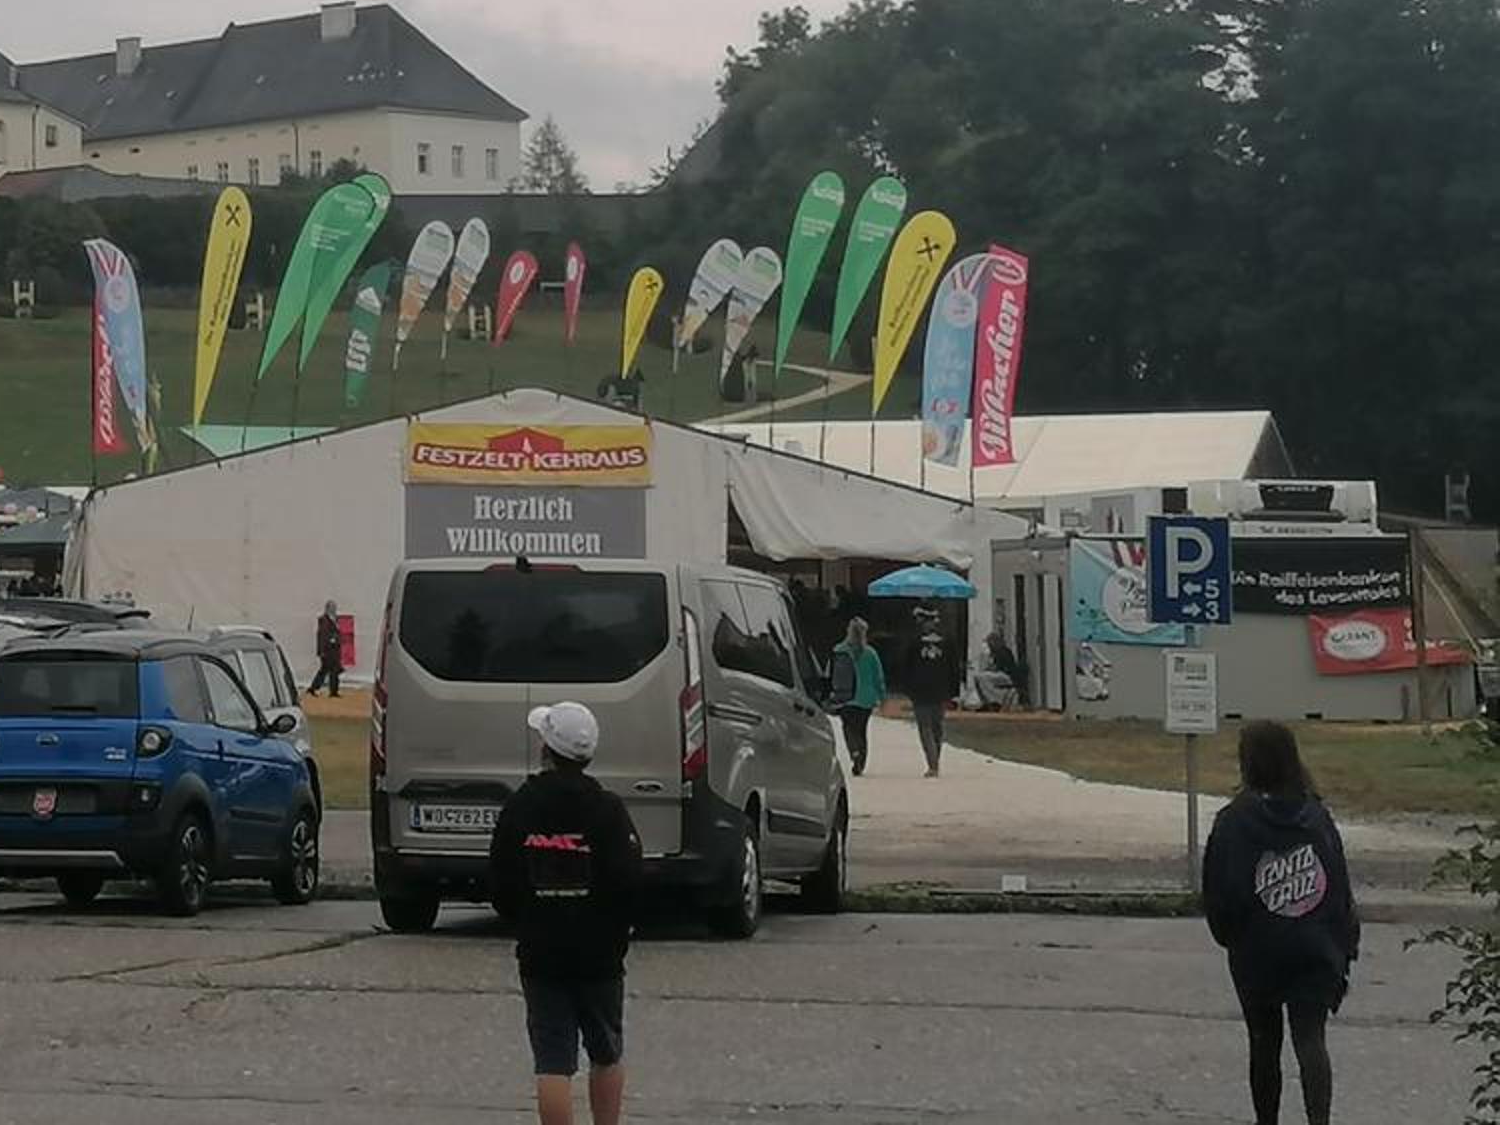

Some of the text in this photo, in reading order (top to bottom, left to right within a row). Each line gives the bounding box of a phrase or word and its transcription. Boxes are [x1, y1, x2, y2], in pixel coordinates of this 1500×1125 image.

[416, 445, 646, 470] FESTZELT KEHRAUS
[473, 495, 573, 521] Herzlich
[446, 526, 601, 555] Willkommen
[1165, 526, 1214, 599] P
[1205, 579, 1220, 600] 5
[1205, 600, 1220, 620] 3
[1254, 844, 1315, 894] SANTA
[1266, 872, 1317, 912] CRUZ
